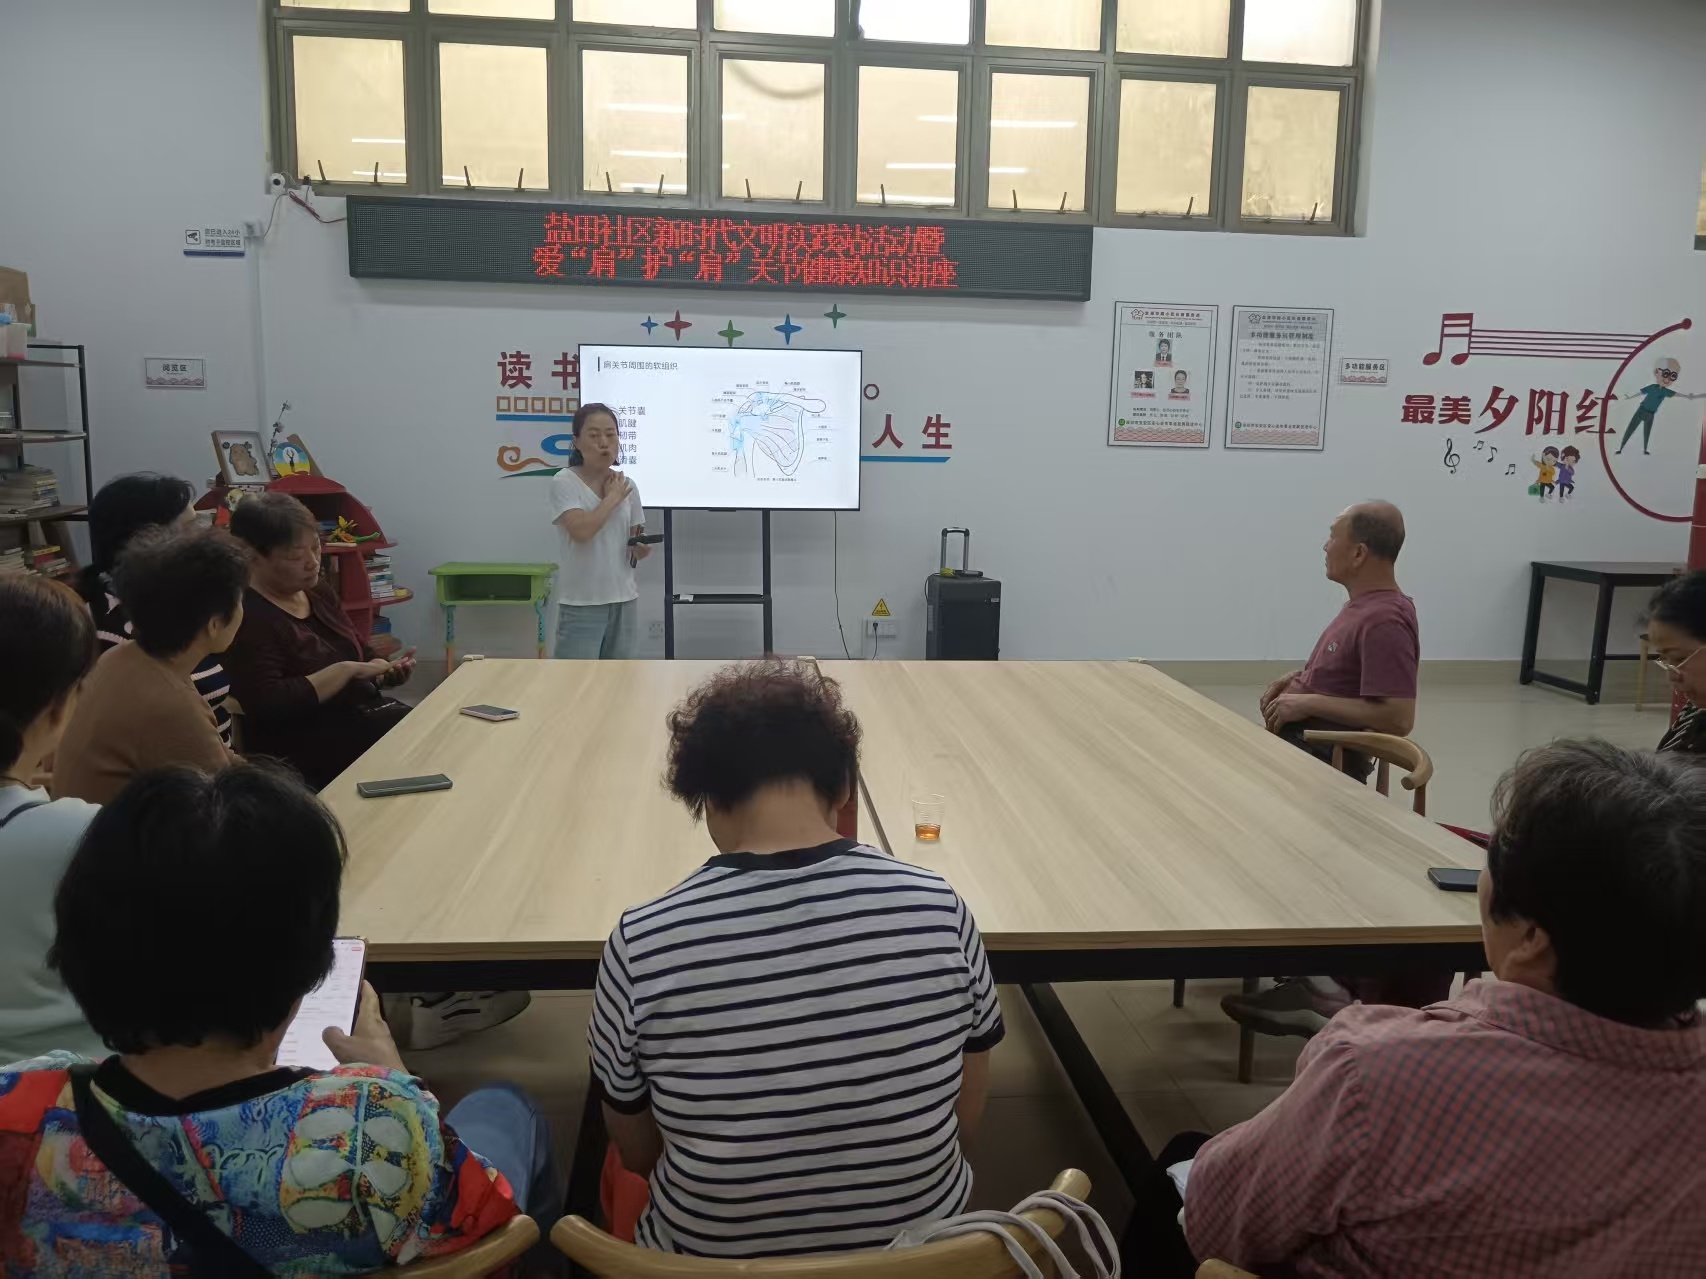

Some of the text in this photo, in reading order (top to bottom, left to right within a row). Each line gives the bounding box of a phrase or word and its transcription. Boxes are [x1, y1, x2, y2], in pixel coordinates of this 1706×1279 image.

[603, 360, 678, 371] 肩关节周围的软组织
[1345, 362, 1386, 371] 多功能服务区
[1401, 386, 1619, 435] 最美夕阳红
